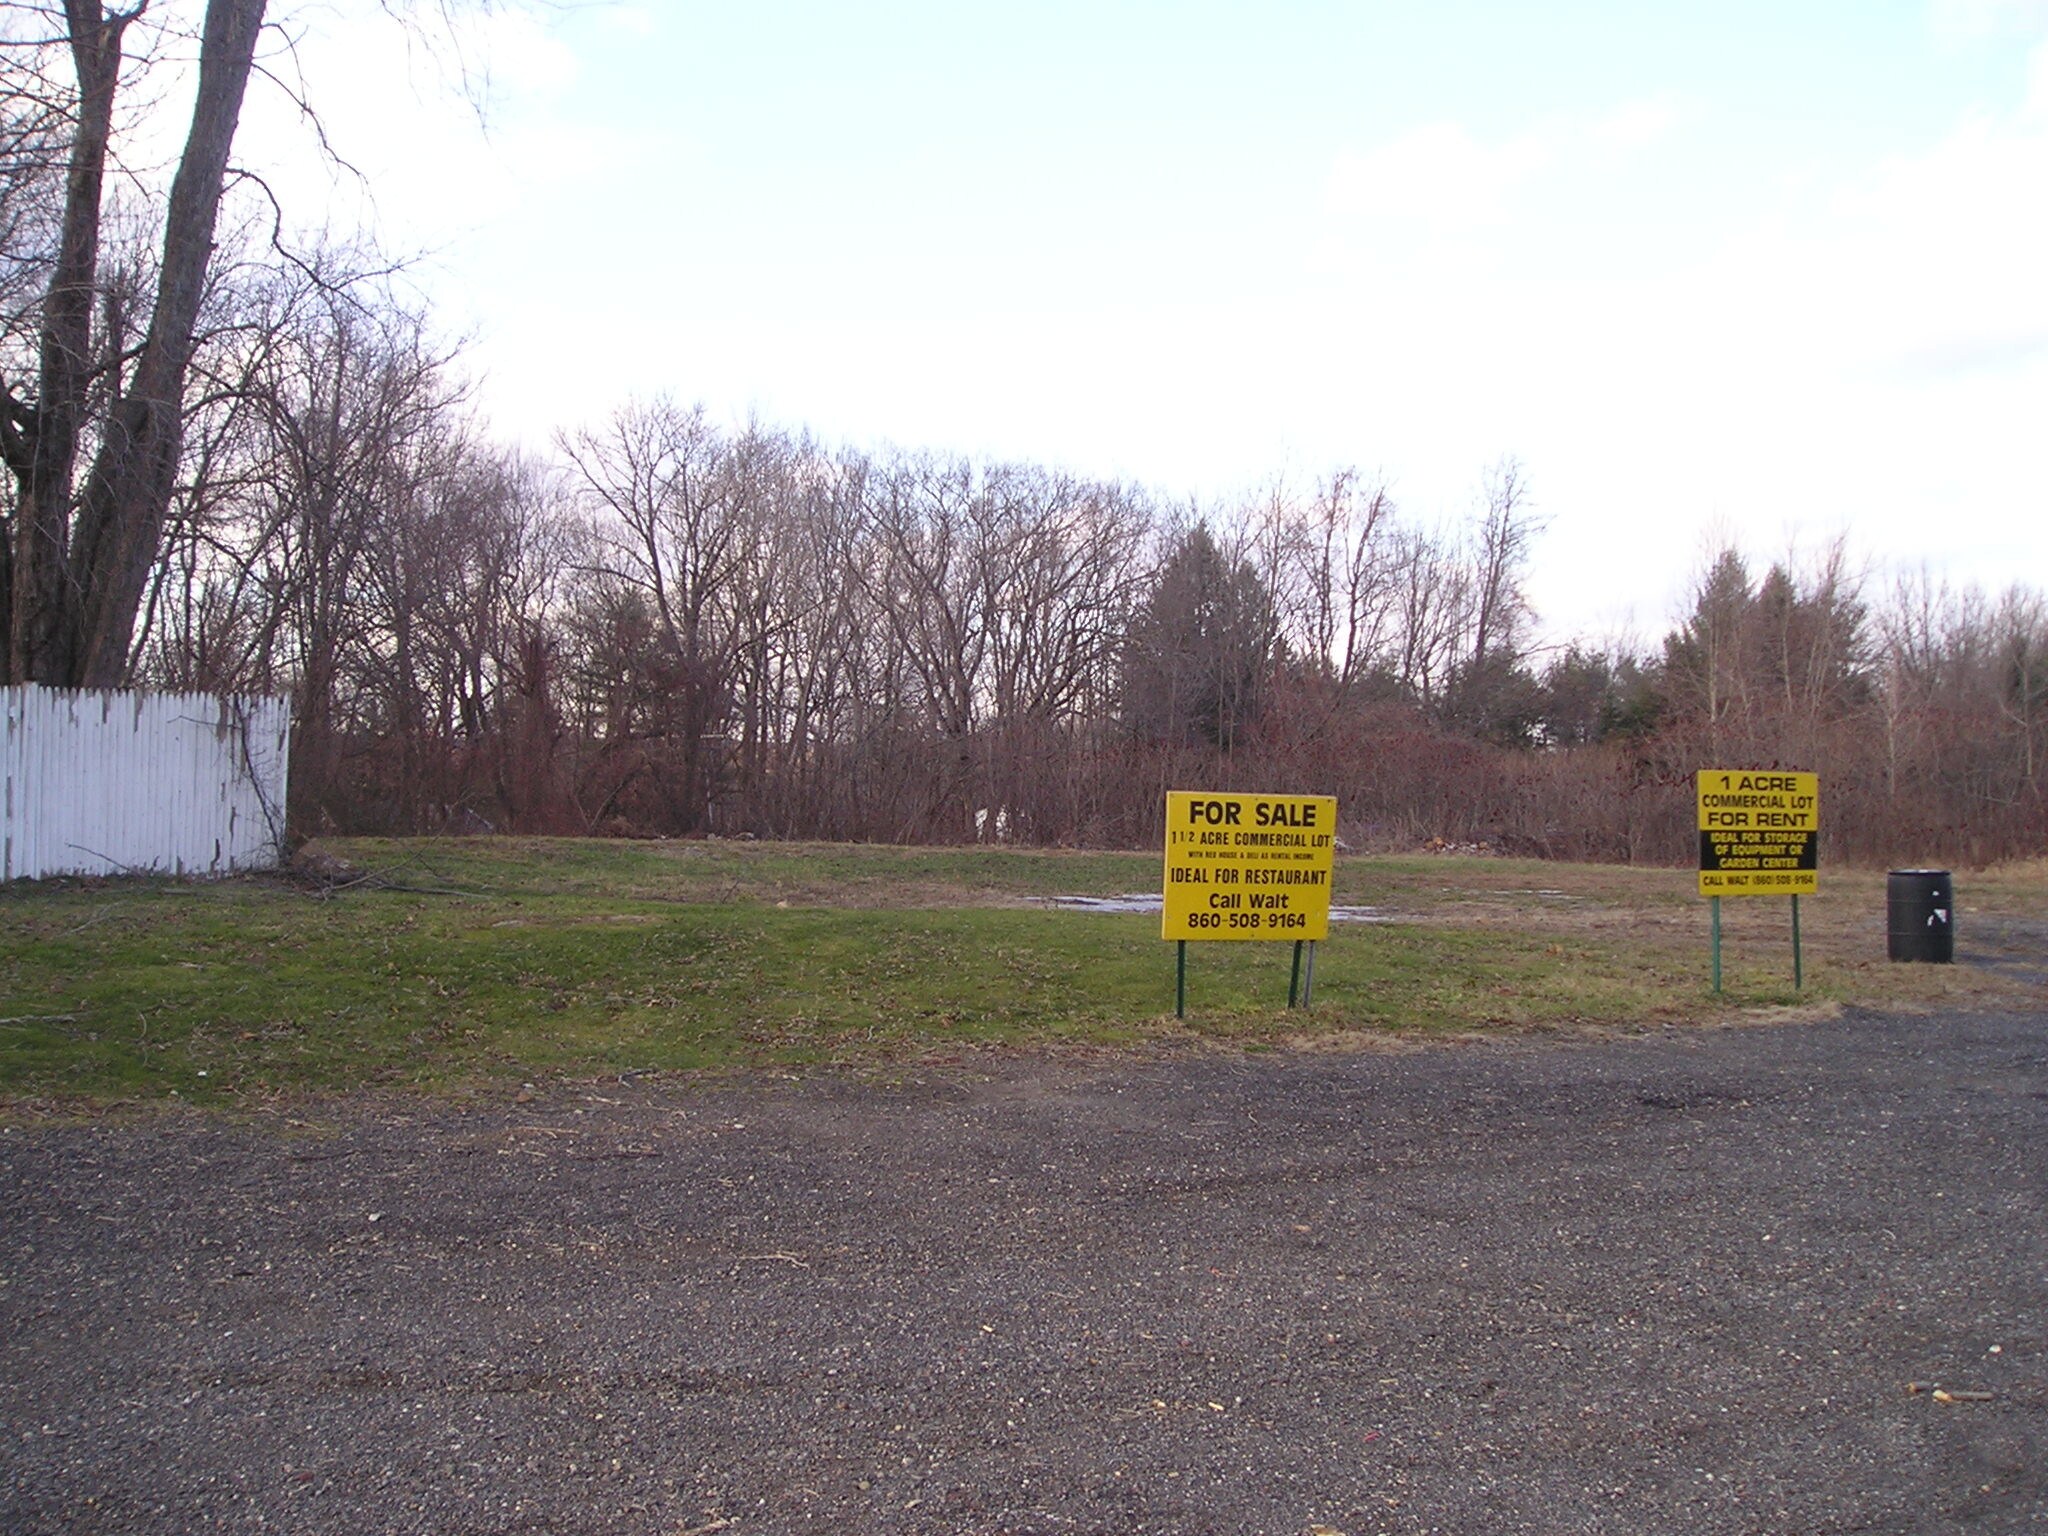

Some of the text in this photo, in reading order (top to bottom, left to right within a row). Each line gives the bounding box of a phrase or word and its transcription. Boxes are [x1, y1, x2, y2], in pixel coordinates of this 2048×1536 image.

[1720, 775, 1797, 791] 1 ACRE
[1702, 794, 1814, 809] COMMERCIAL LOT
[1190, 801, 1317, 827] FOR SALE
[1708, 812, 1809, 827] FOR RENT
[1200, 832, 1229, 845] ACRE
[1234, 832, 1307, 847] COMMERCIAL
[1311, 834, 1331, 848] LOT
[1710, 832, 1808, 843] IDEAL FOR STORAGE
[1714, 844, 1804, 855] OF EQUIPMENT OR
[1719, 858, 1799, 868] GARDEN CENTER
[1171, 867, 1327, 885] IDEAL FOR RESTAURANT
[1703, 875, 1724, 886] CALL
[1727, 875, 1749, 886] WALT
[1209, 893, 1289, 909] Call Walt
[1188, 913, 1306, 928] 860-508-9164
